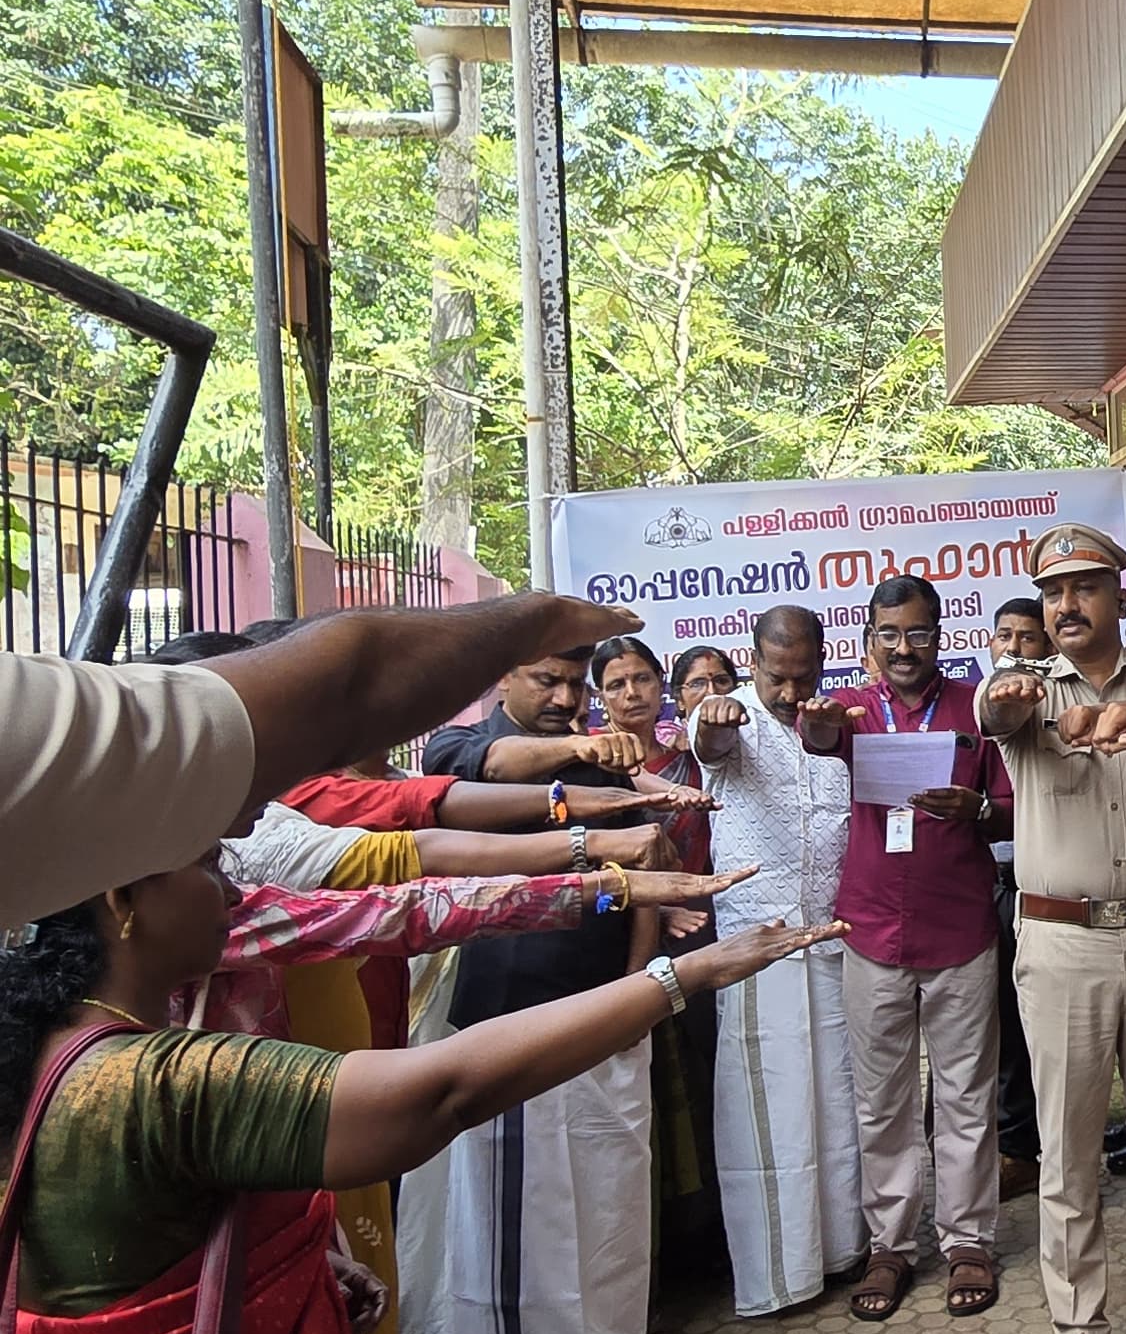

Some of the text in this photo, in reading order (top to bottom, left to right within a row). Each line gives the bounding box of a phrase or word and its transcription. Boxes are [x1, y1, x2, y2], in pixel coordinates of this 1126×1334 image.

[722, 491, 1058, 537] പള്ളിക്കൽ ഗ്രാമപഞ്ചായത്ത്
[587, 551, 810, 604] ഓപ്പറേഷൻ
